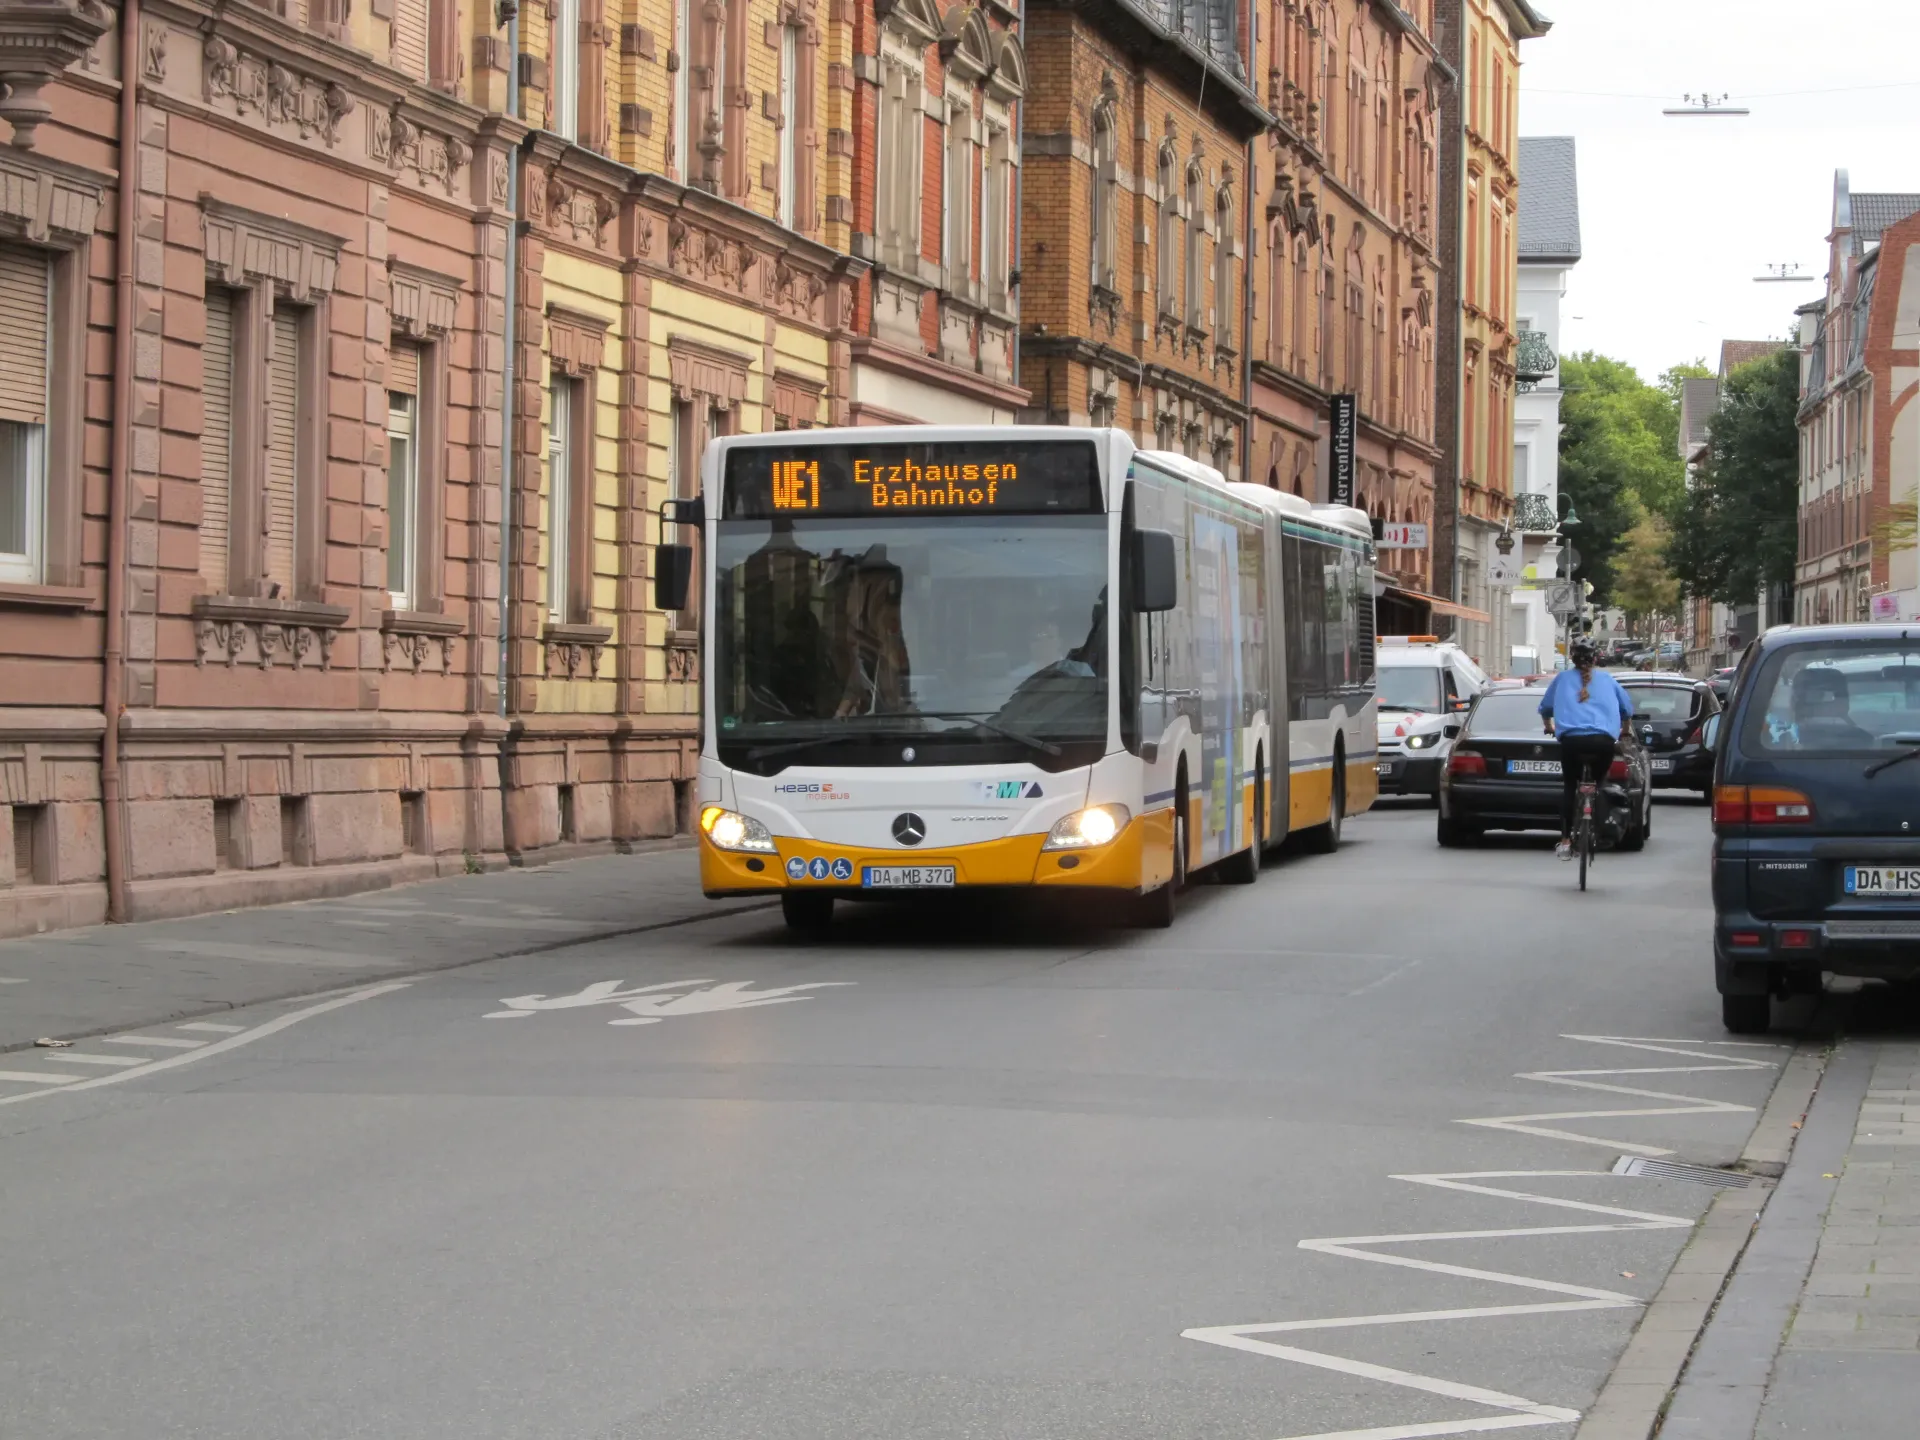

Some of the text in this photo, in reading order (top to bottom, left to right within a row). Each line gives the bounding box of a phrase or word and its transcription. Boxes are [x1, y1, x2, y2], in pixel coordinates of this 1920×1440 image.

[854, 459, 1017, 483] Erzhausen
[773, 461, 818, 508] WE1
[872, 482, 998, 506] Bahnhof
[1513, 761, 1526, 772] DA
[1532, 761, 1546, 772] EE
[872, 869, 953, 884] DA MB 370
[1857, 870, 1882, 889] DA
[1896, 870, 1920, 889] HS
